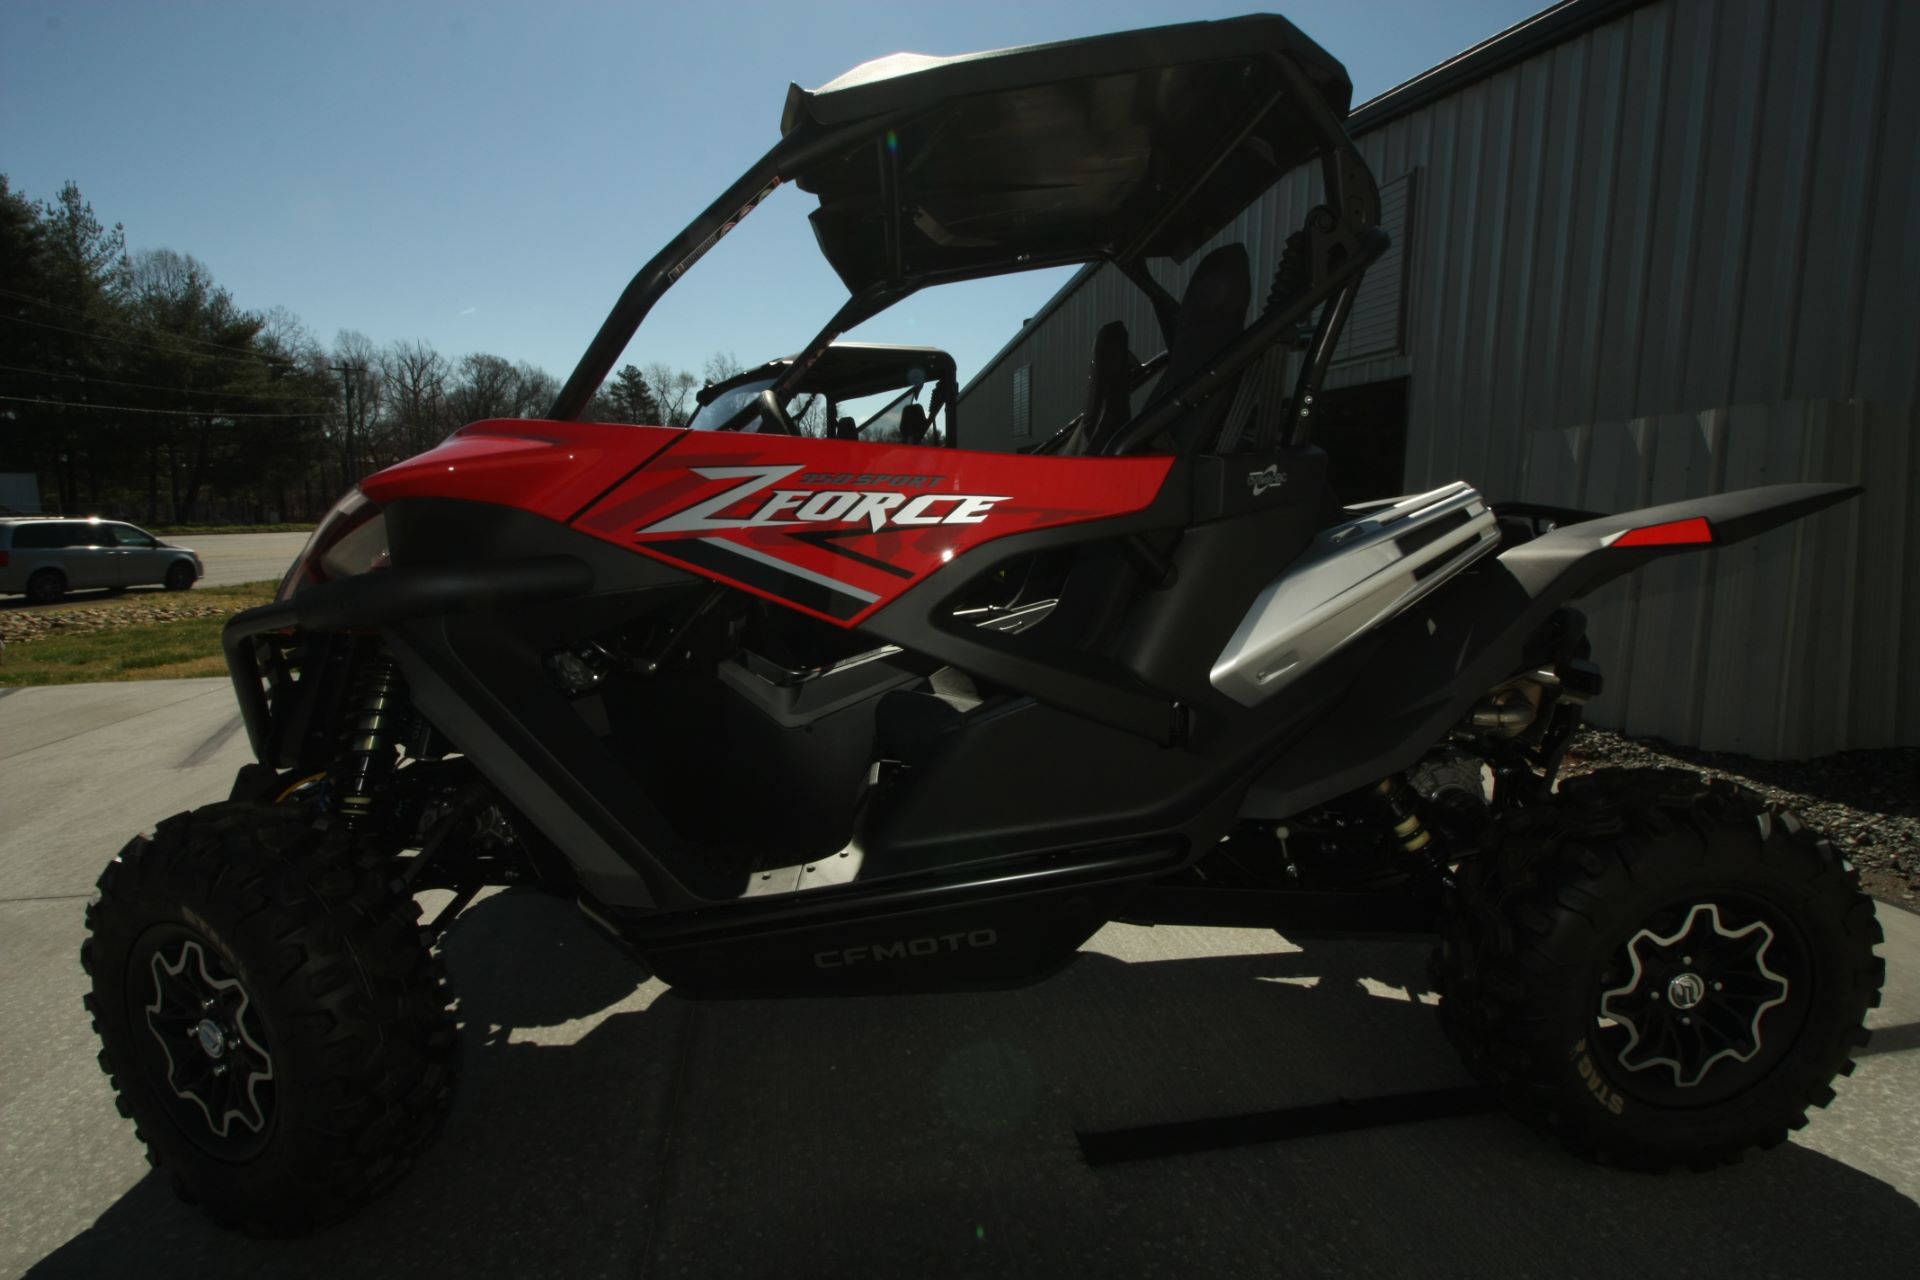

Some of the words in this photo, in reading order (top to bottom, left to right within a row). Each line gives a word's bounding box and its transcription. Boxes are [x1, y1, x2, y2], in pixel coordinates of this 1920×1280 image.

[800, 473, 851, 485] 950
[852, 473, 945, 487] SPORT
[813, 928, 998, 969] CFMOTO
